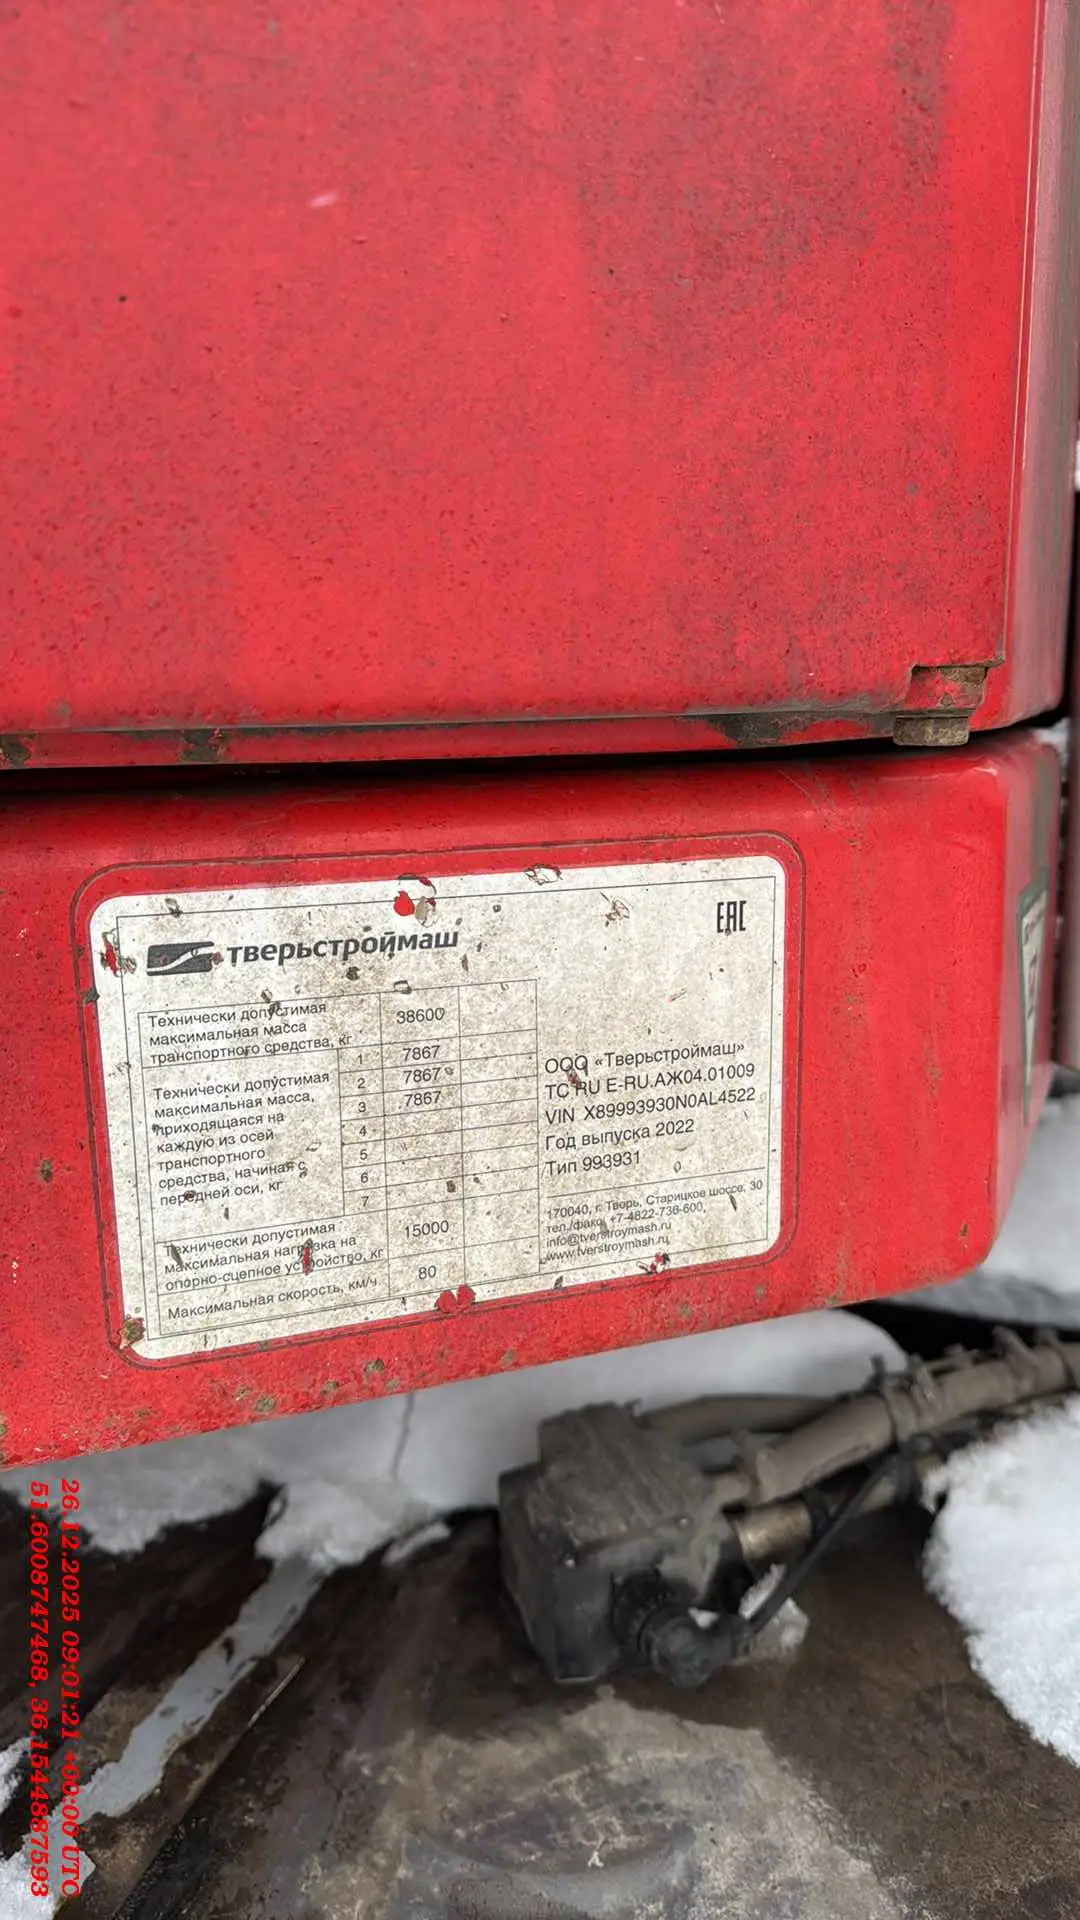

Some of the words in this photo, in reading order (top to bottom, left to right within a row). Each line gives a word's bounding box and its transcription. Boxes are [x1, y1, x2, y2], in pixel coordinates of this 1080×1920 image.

[148, 1009, 236, 1028] Технически
[240, 1003, 326, 1022] допустимая
[396, 1008, 445, 1024] 38600
[150, 1027, 259, 1046] максимальная
[263, 1022, 307, 1036] масса
[150, 1045, 260, 1066] транспортного
[264, 1036, 334, 1055] средства,
[339, 1035, 352, 1046] кг
[358, 1054, 363, 1064] 1
[403, 1045, 440, 1061] 7867
[595, 1043, 744, 1068] «Тверьстроймаш»
[154, 1082, 240, 1101] Технически
[244, 1073, 329, 1093] допустимая
[357, 1078, 365, 1089] 2
[403, 1067, 441, 1084] 7867
[404, 1091, 441, 1107] 7867
[575, 1080, 600, 1096] RU
[154, 1096, 263, 1118] максимальная
[267, 1092, 314, 1106] масса,
[358, 1102, 366, 1113] 3
[545, 1109, 575, 1125] VIN
[584, 1087, 756, 1121] X89993930N0AL4522
[152, 1115, 263, 1137] приходящаяся
[268, 1113, 284, 1123] на
[359, 1126, 366, 1137] 4
[545, 1135, 576, 1150] Год
[582, 1127, 650, 1147] выпуска
[655, 1119, 694, 1136] 2022
[157, 1136, 214, 1154] каждую
[219, 1136, 236, 1146] из
[240, 1129, 274, 1143] осей
[158, 1148, 265, 1172] транспортного
[359, 1150, 368, 1160] 5
[545, 1160, 577, 1176] Тип
[582, 1150, 640, 1171] 993931
[159, 1171, 230, 1191] средства,
[235, 1162, 294, 1178] начиная
[298, 1161, 306, 1171] с
[235, 1183, 263, 1195] оси,
[269, 1180, 283, 1191] кг
[361, 1172, 368, 1183] 6
[361, 1196, 369, 1207] 7
[607, 1199, 642, 1211] Тверь,
[646, 1190, 706, 1206] Старицкое
[750, 1180, 763, 1191] 30
[253, 1222, 335, 1246] допустимая
[404, 1220, 450, 1239] 15000
[547, 1221, 671, 1248] info@tverstroymash.ru
[164, 1249, 270, 1274] максимальная
[274, 1241, 336, 1261] нагрзка
[340, 1236, 357, 1247] на
[165, 1263, 281, 1291] опорно-сцепное
[371, 1248, 384, 1260] кг
[418, 1265, 437, 1280] 80
[168, 1294, 274, 1320] Максимальная
[278, 1283, 344, 1303] скорость,
[349, 1277, 377, 1291] км/ч
